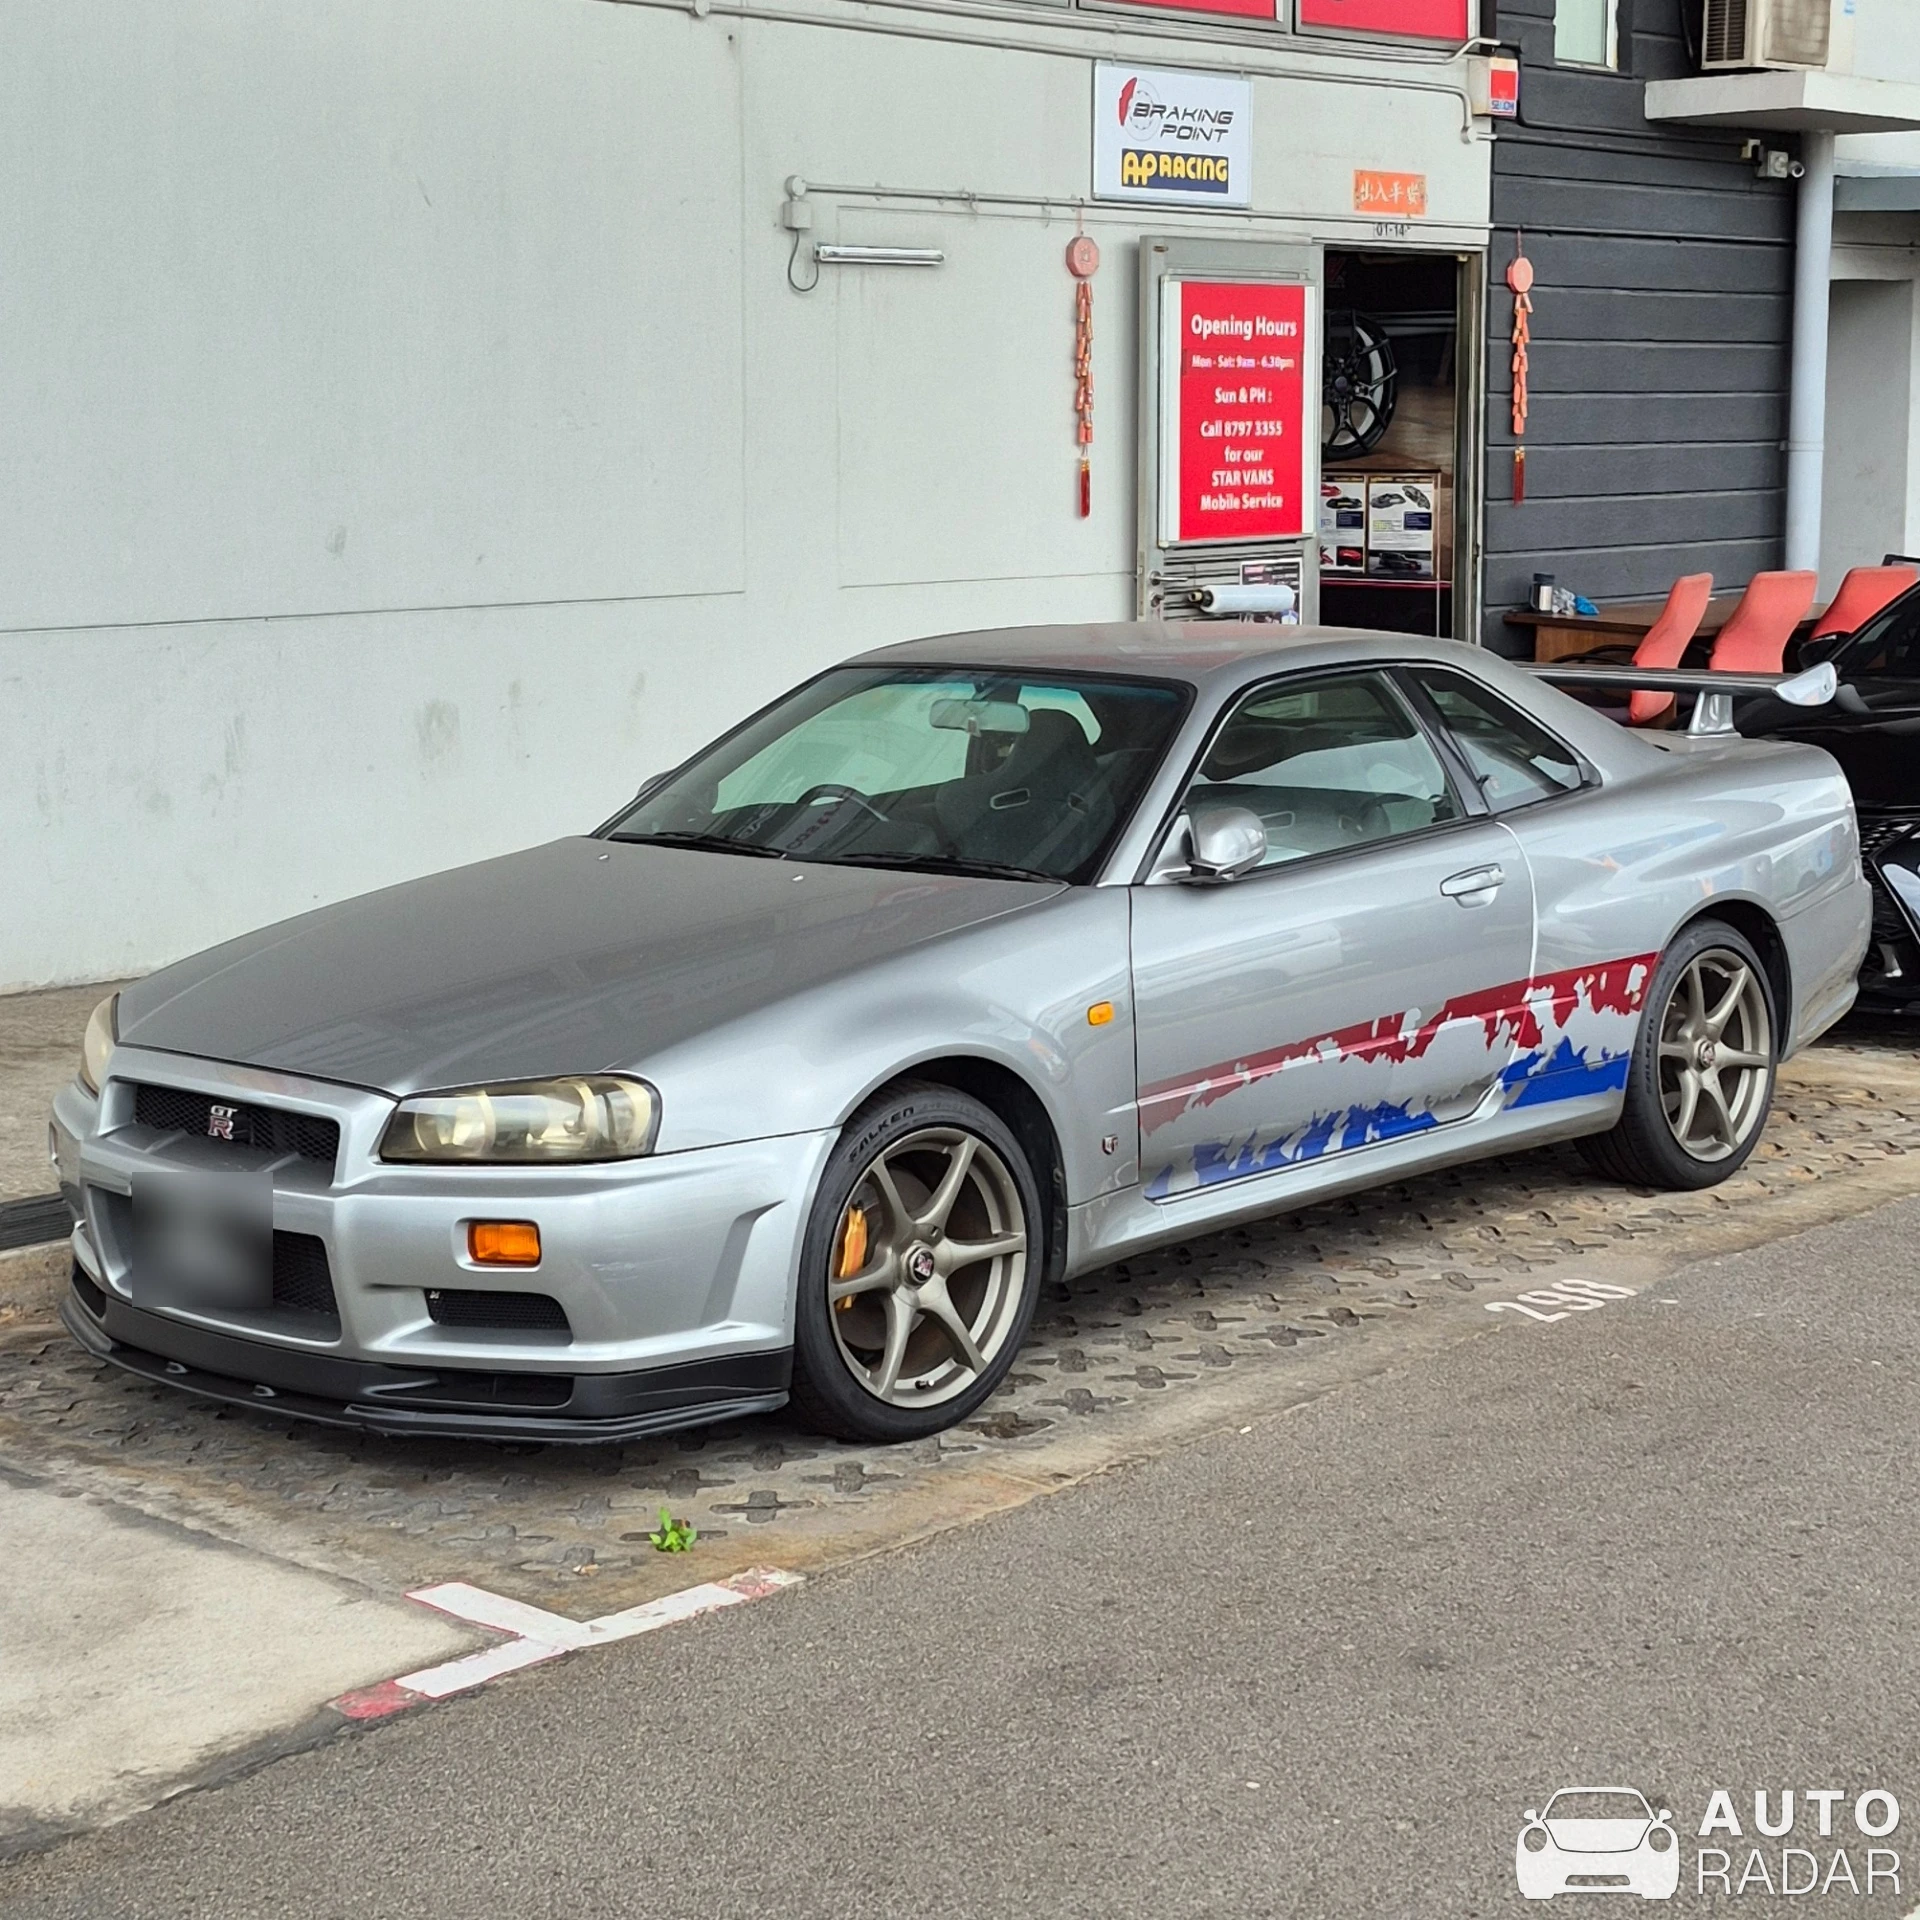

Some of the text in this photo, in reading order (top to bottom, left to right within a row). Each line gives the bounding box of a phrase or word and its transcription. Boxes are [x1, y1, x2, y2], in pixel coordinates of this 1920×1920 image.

[1133, 102, 1234, 125] BRAKING
[1160, 124, 1229, 143] POINT
[1122, 151, 1228, 186] AP RACING
[1191, 314, 1297, 341] Opening Hours
[1191, 355, 1212, 368] Mon
[1214, 387, 1237, 404] Sun
[1238, 387, 1248, 404] &
[1249, 387, 1266, 404] PH
[1200, 420, 1223, 438] Call
[1254, 420, 1283, 437] 3355
[1224, 445, 1264, 463] for our
[1211, 469, 1274, 487] STAR VANS
[1200, 492, 1284, 511] Mobile Service
[210, 1105, 238, 1117] GT
[207, 1115, 234, 1141] R
[848, 1106, 915, 1162] FALKEN
